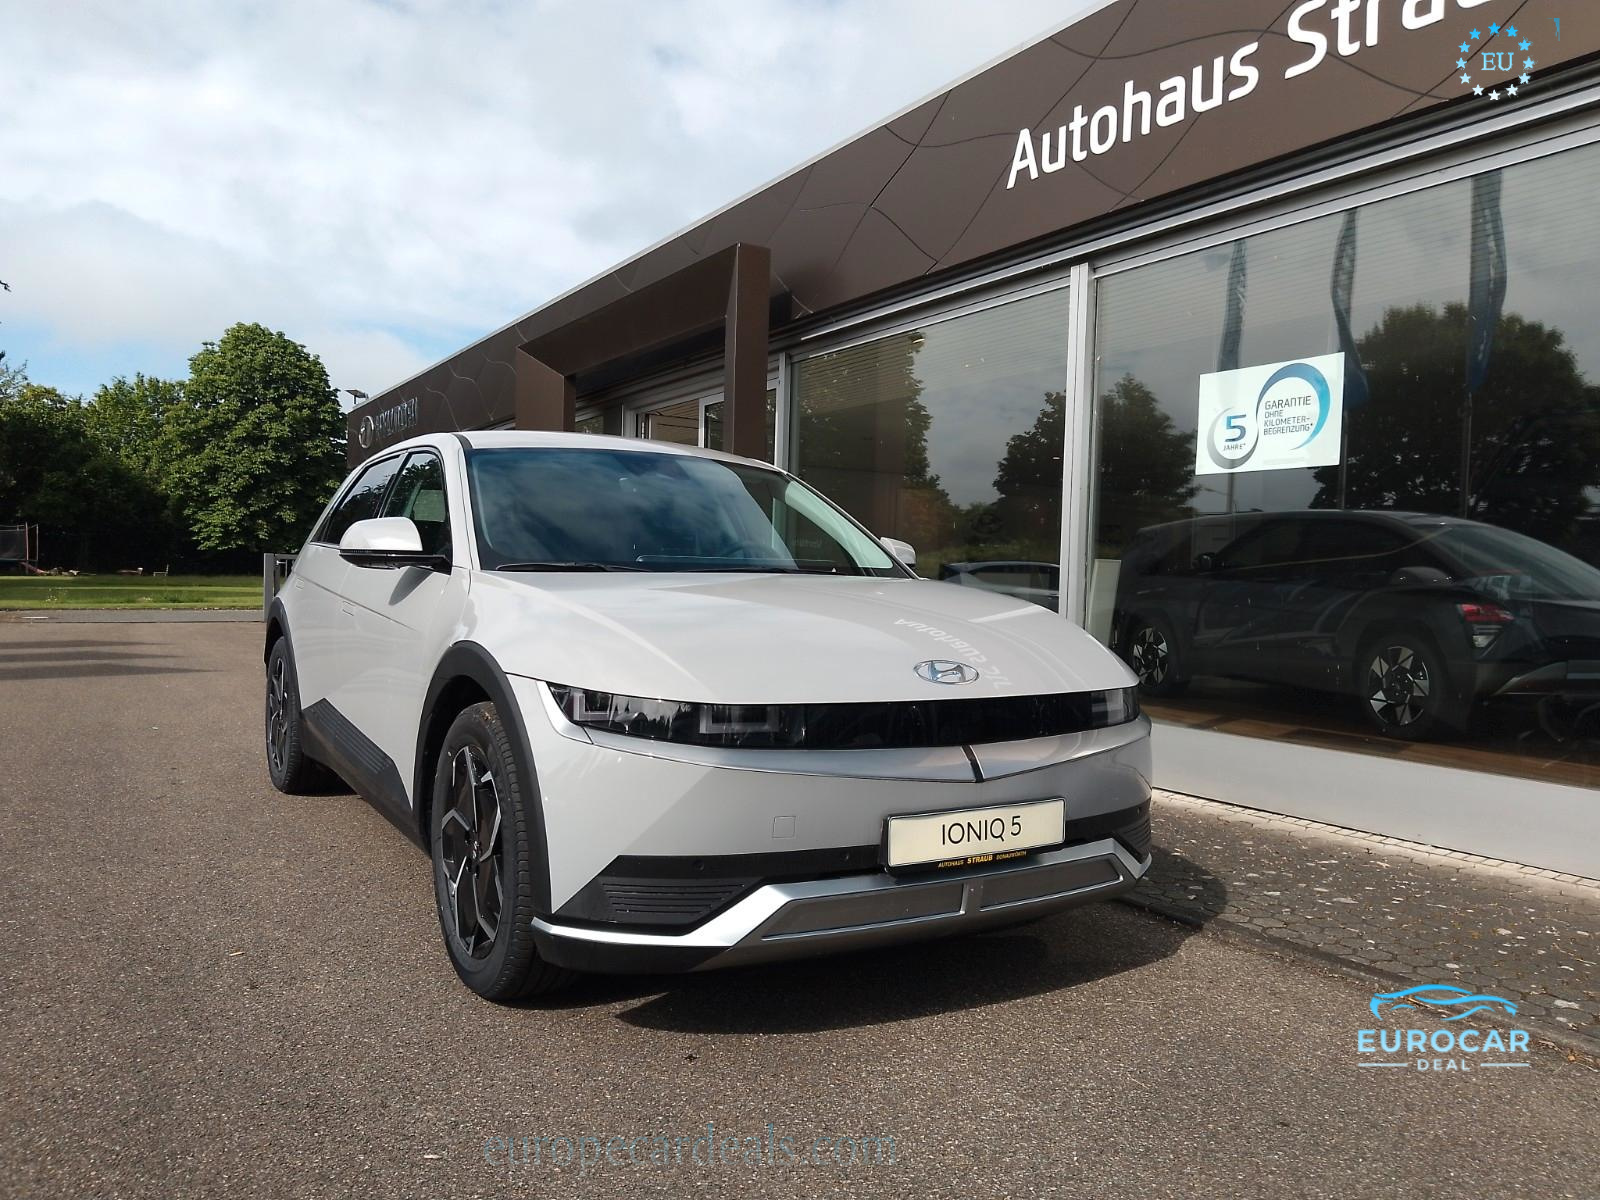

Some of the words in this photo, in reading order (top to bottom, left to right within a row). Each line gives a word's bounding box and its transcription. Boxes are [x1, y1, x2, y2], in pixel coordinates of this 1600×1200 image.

[1005, 41, 1260, 189] Autohaus
[1284, 0, 1494, 80] Stra
[1264, 395, 1312, 411] GARANTIE
[1263, 416, 1311, 427] KILOMETER-
[1264, 409, 1284, 419] OHNE
[1224, 413, 1247, 443] 5
[942, 817, 1005, 846] IONIQ
[1010, 815, 1022, 836] 5
[937, 859, 964, 868] AUTOHAUS
[967, 854, 993, 865] STRAUB
